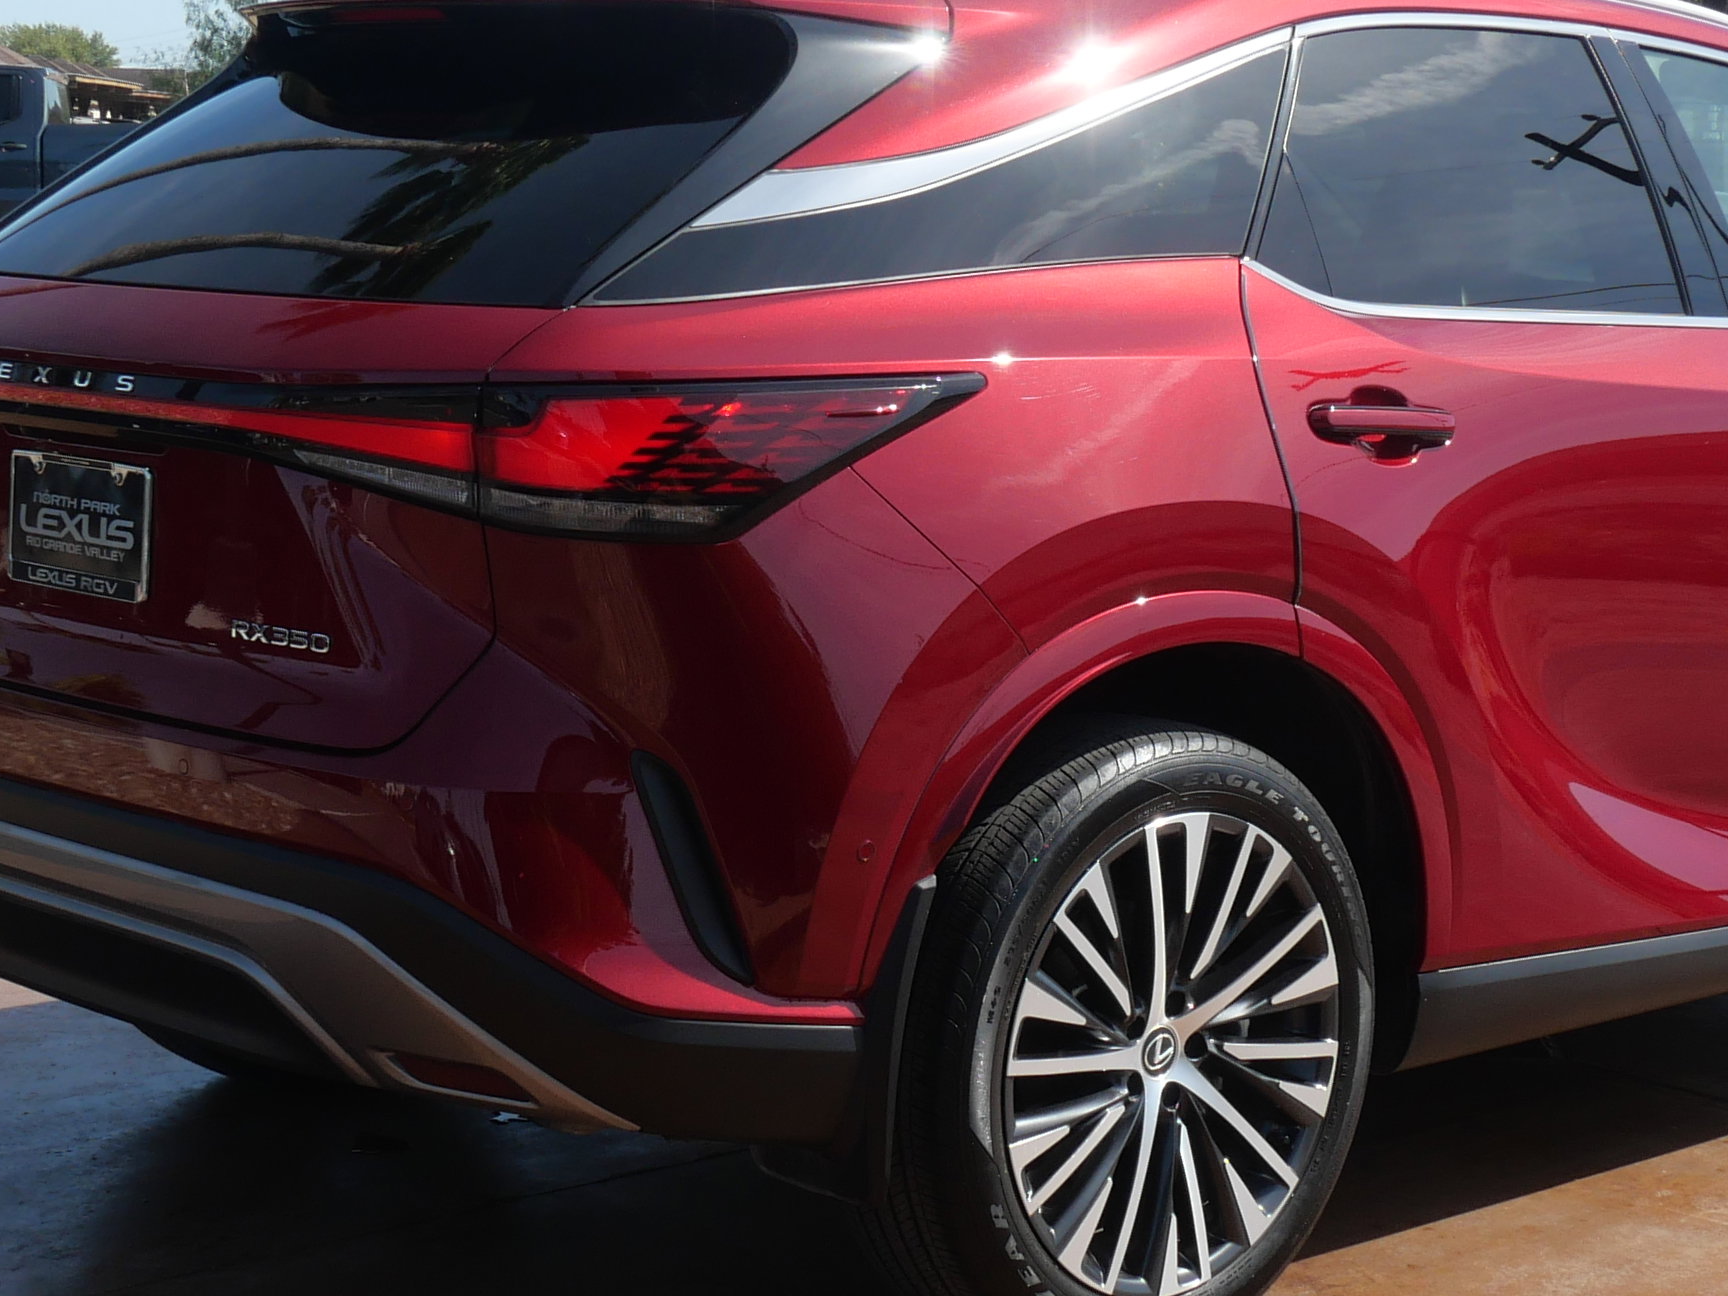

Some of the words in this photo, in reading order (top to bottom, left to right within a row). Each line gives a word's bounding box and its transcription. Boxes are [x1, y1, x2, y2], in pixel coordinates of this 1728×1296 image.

[33, 491, 77, 509] NORTH
[81, 499, 120, 516] PARK
[19, 503, 134, 550] LEXUS
[26, 535, 41, 547] RIO
[42, 538, 82, 555] GRANDE
[84, 545, 125, 562] VALLEY
[28, 566, 76, 587] LEXUS
[80, 576, 117, 595] RGV
[231, 619, 330, 653] RX350
[1183, 771, 1285, 805] EAGLE
